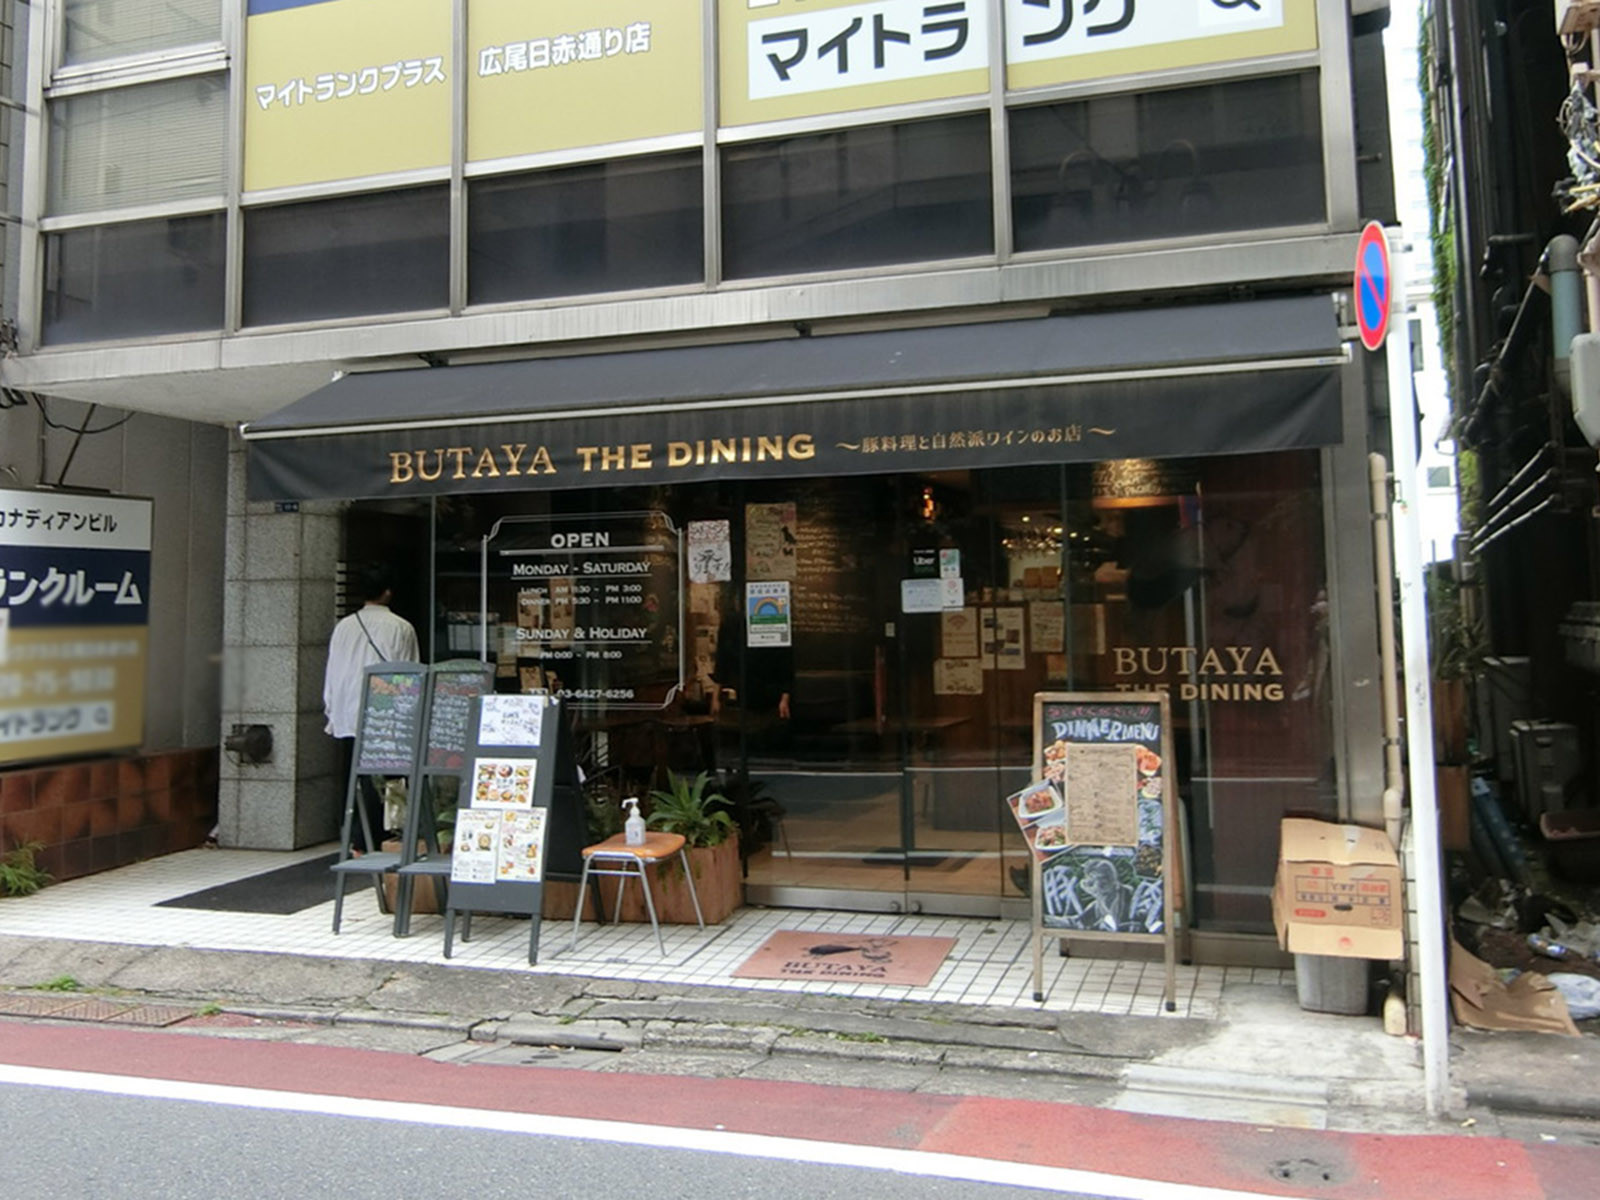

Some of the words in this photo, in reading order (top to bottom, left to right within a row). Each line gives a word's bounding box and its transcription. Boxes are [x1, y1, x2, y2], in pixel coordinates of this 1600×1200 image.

[479, 22, 652, 76] 広尾日赤通り店
[256, 56, 446, 109] マイトランクプラス
[389, 443, 557, 484] BUTAYA
[576, 443, 653, 472] THE
[667, 433, 816, 468] DINING
[551, 532, 610, 548] OPEN
[0, 567, 142, 606] ンクルーム
[516, 628, 569, 640] SUNDAY
[590, 627, 647, 639] HOLIDAY
[1113, 646, 1283, 675] BUTAYA
[1180, 683, 1285, 701] DINING
[784, 961, 887, 972] BUTAYA
